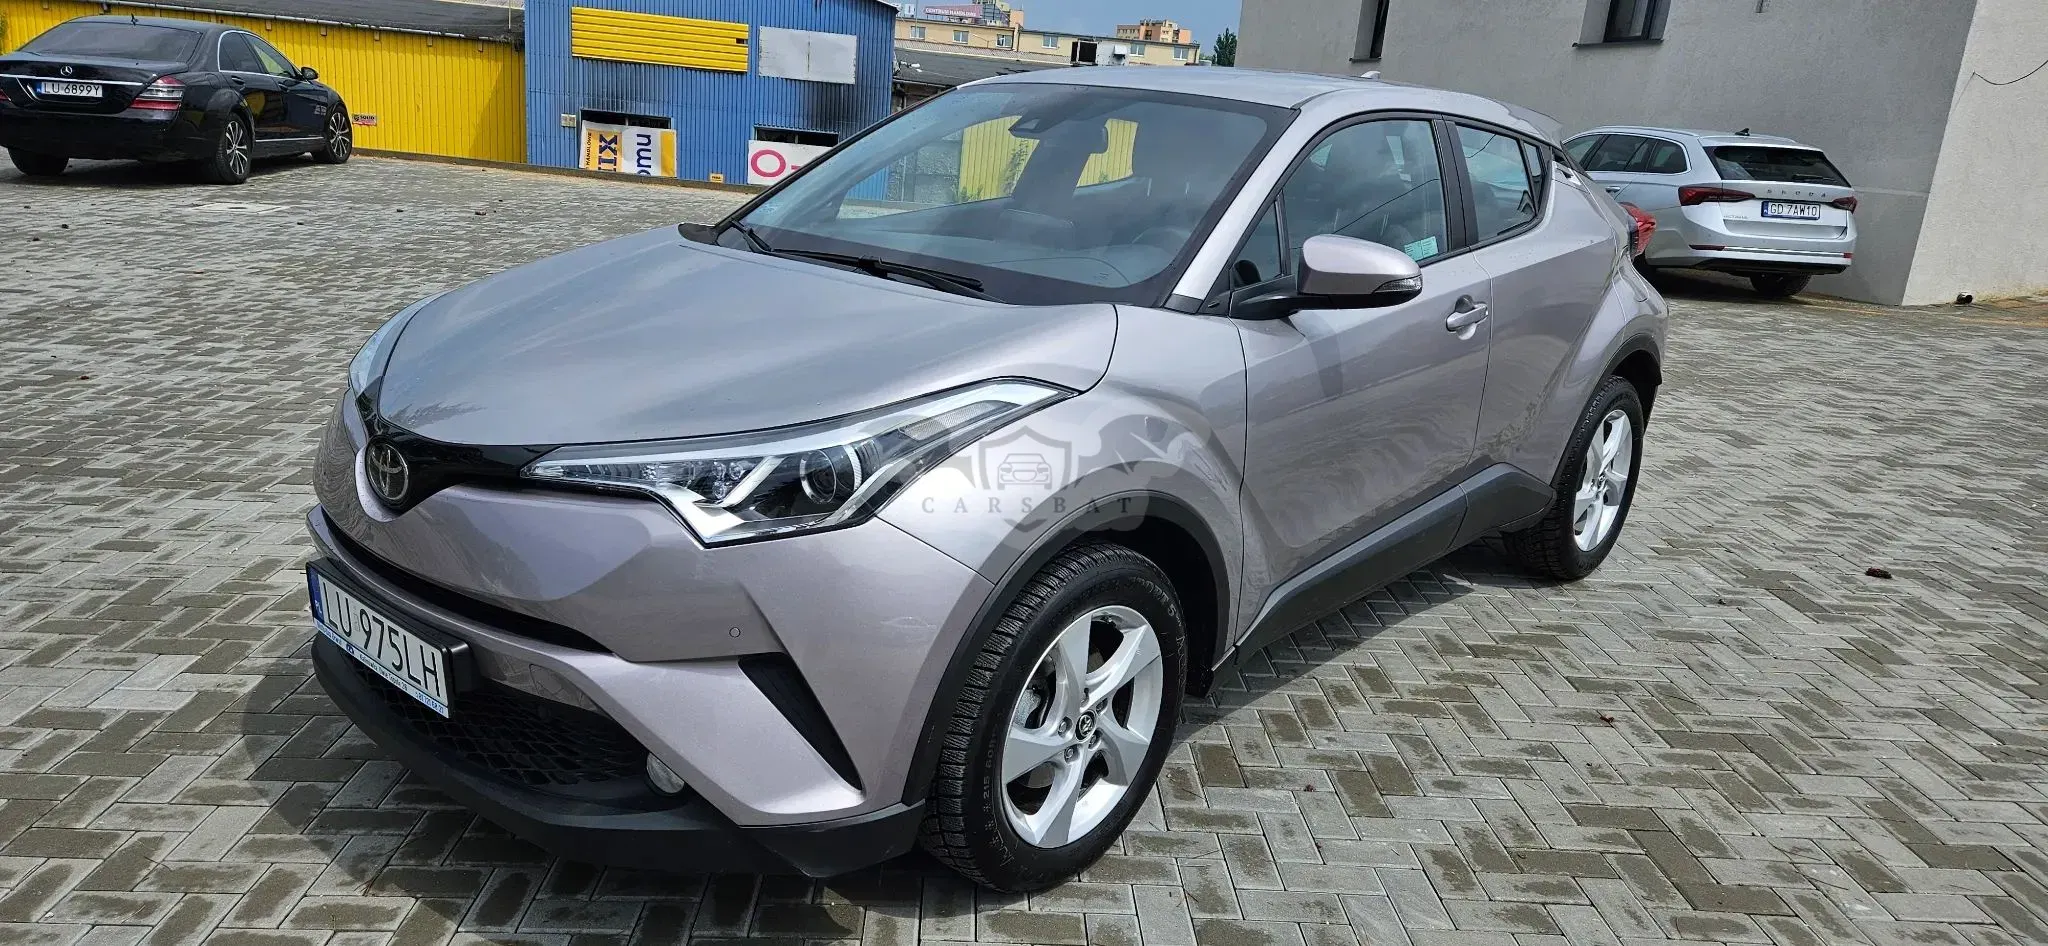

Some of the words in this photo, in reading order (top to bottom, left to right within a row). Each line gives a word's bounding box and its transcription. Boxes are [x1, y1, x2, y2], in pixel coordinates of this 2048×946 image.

[44, 82, 60, 94] LU
[64, 83, 100, 96] 6899Y
[598, 133, 618, 172] IX
[1770, 203, 1784, 215] GD
[1787, 205, 1817, 217] 7AW10
[322, 581, 352, 638] LU
[359, 608, 441, 698] 975LH
